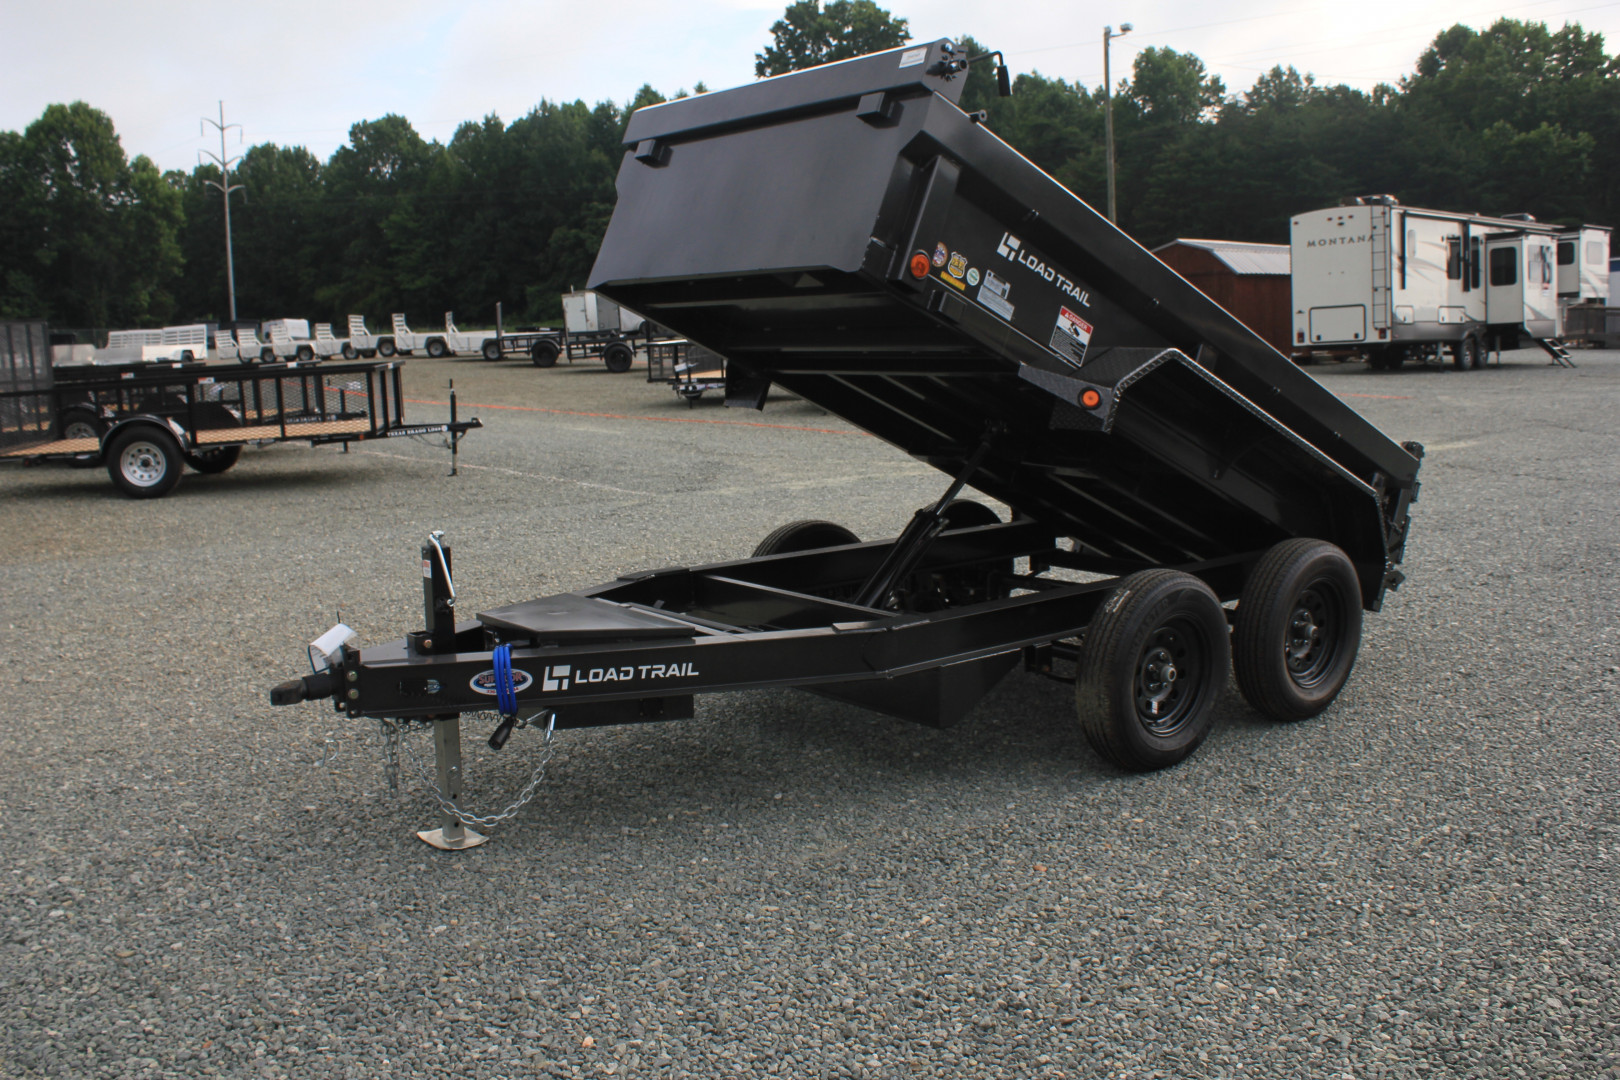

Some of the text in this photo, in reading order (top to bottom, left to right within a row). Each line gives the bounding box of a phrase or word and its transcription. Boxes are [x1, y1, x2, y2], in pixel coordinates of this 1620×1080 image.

[1306, 234, 1375, 248] MONTANA
[1018, 249, 1055, 282] LOAD
[1056, 273, 1090, 307] TRAIL
[574, 662, 700, 684] LOAD TRAIL
